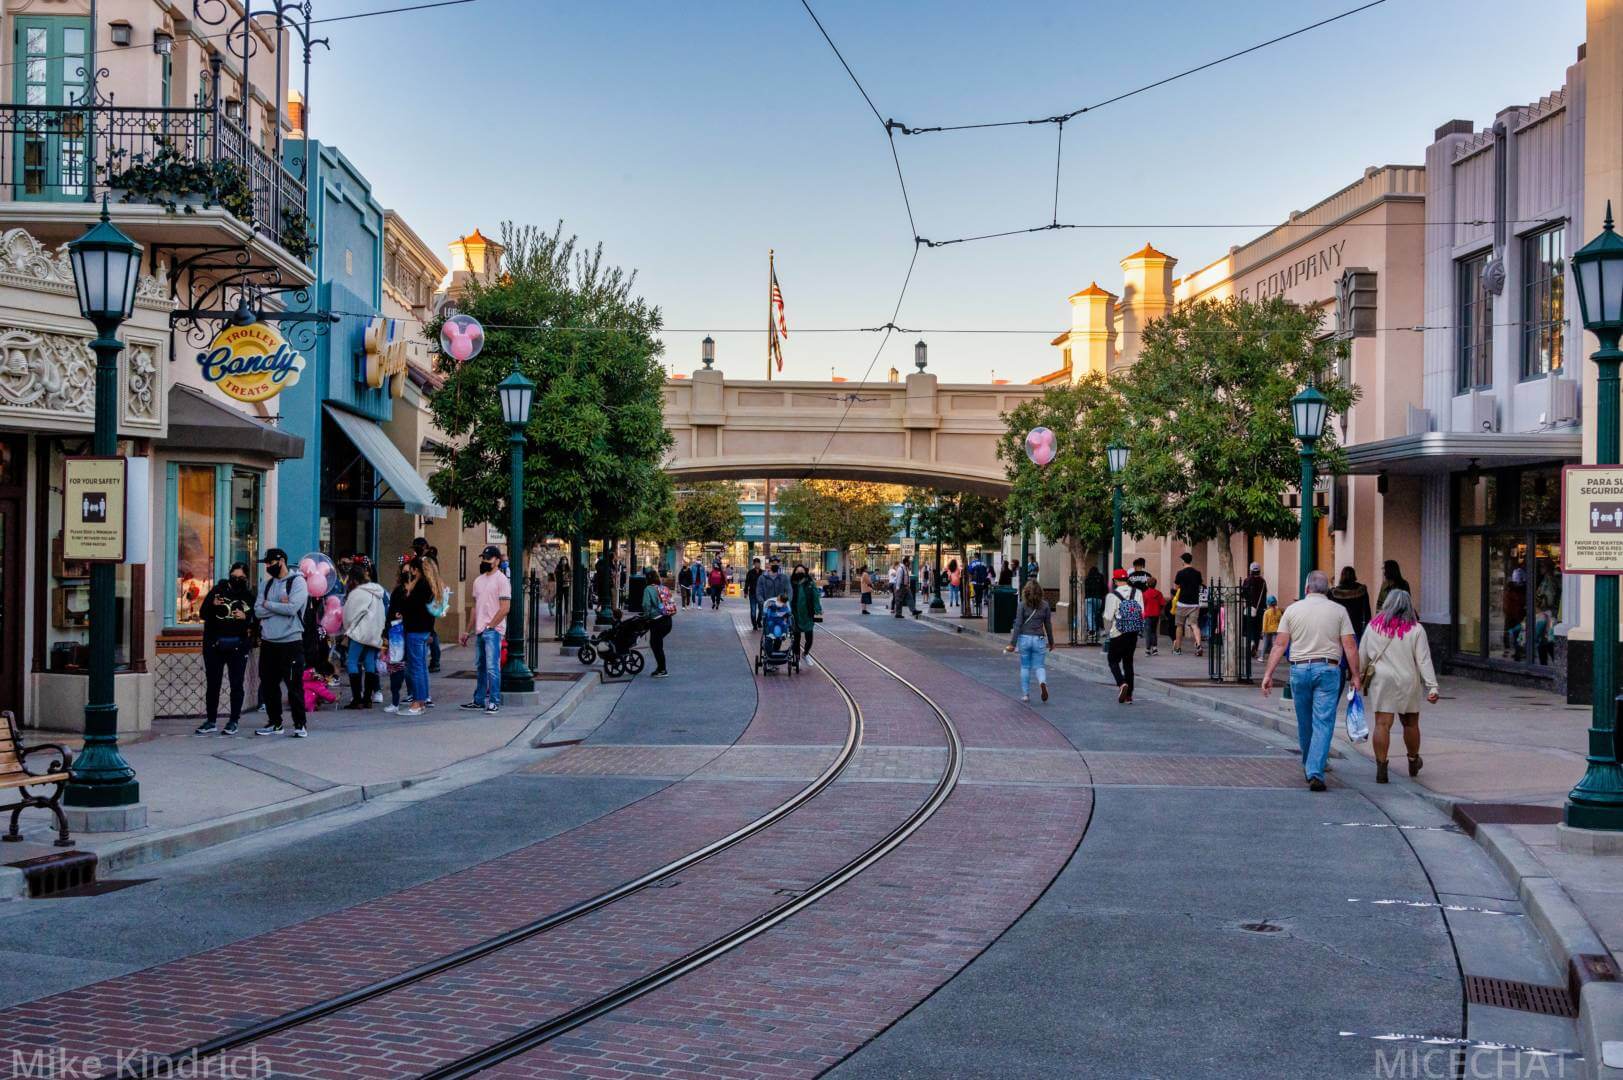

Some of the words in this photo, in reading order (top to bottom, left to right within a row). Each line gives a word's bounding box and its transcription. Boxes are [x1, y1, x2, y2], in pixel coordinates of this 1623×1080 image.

[1256, 239, 1346, 304] COMPANY
[225, 329, 277, 348] TROLLEY
[197, 344, 299, 382] Candy
[225, 381, 269, 396] TREATS
[1587, 478, 1612, 486] PARA
